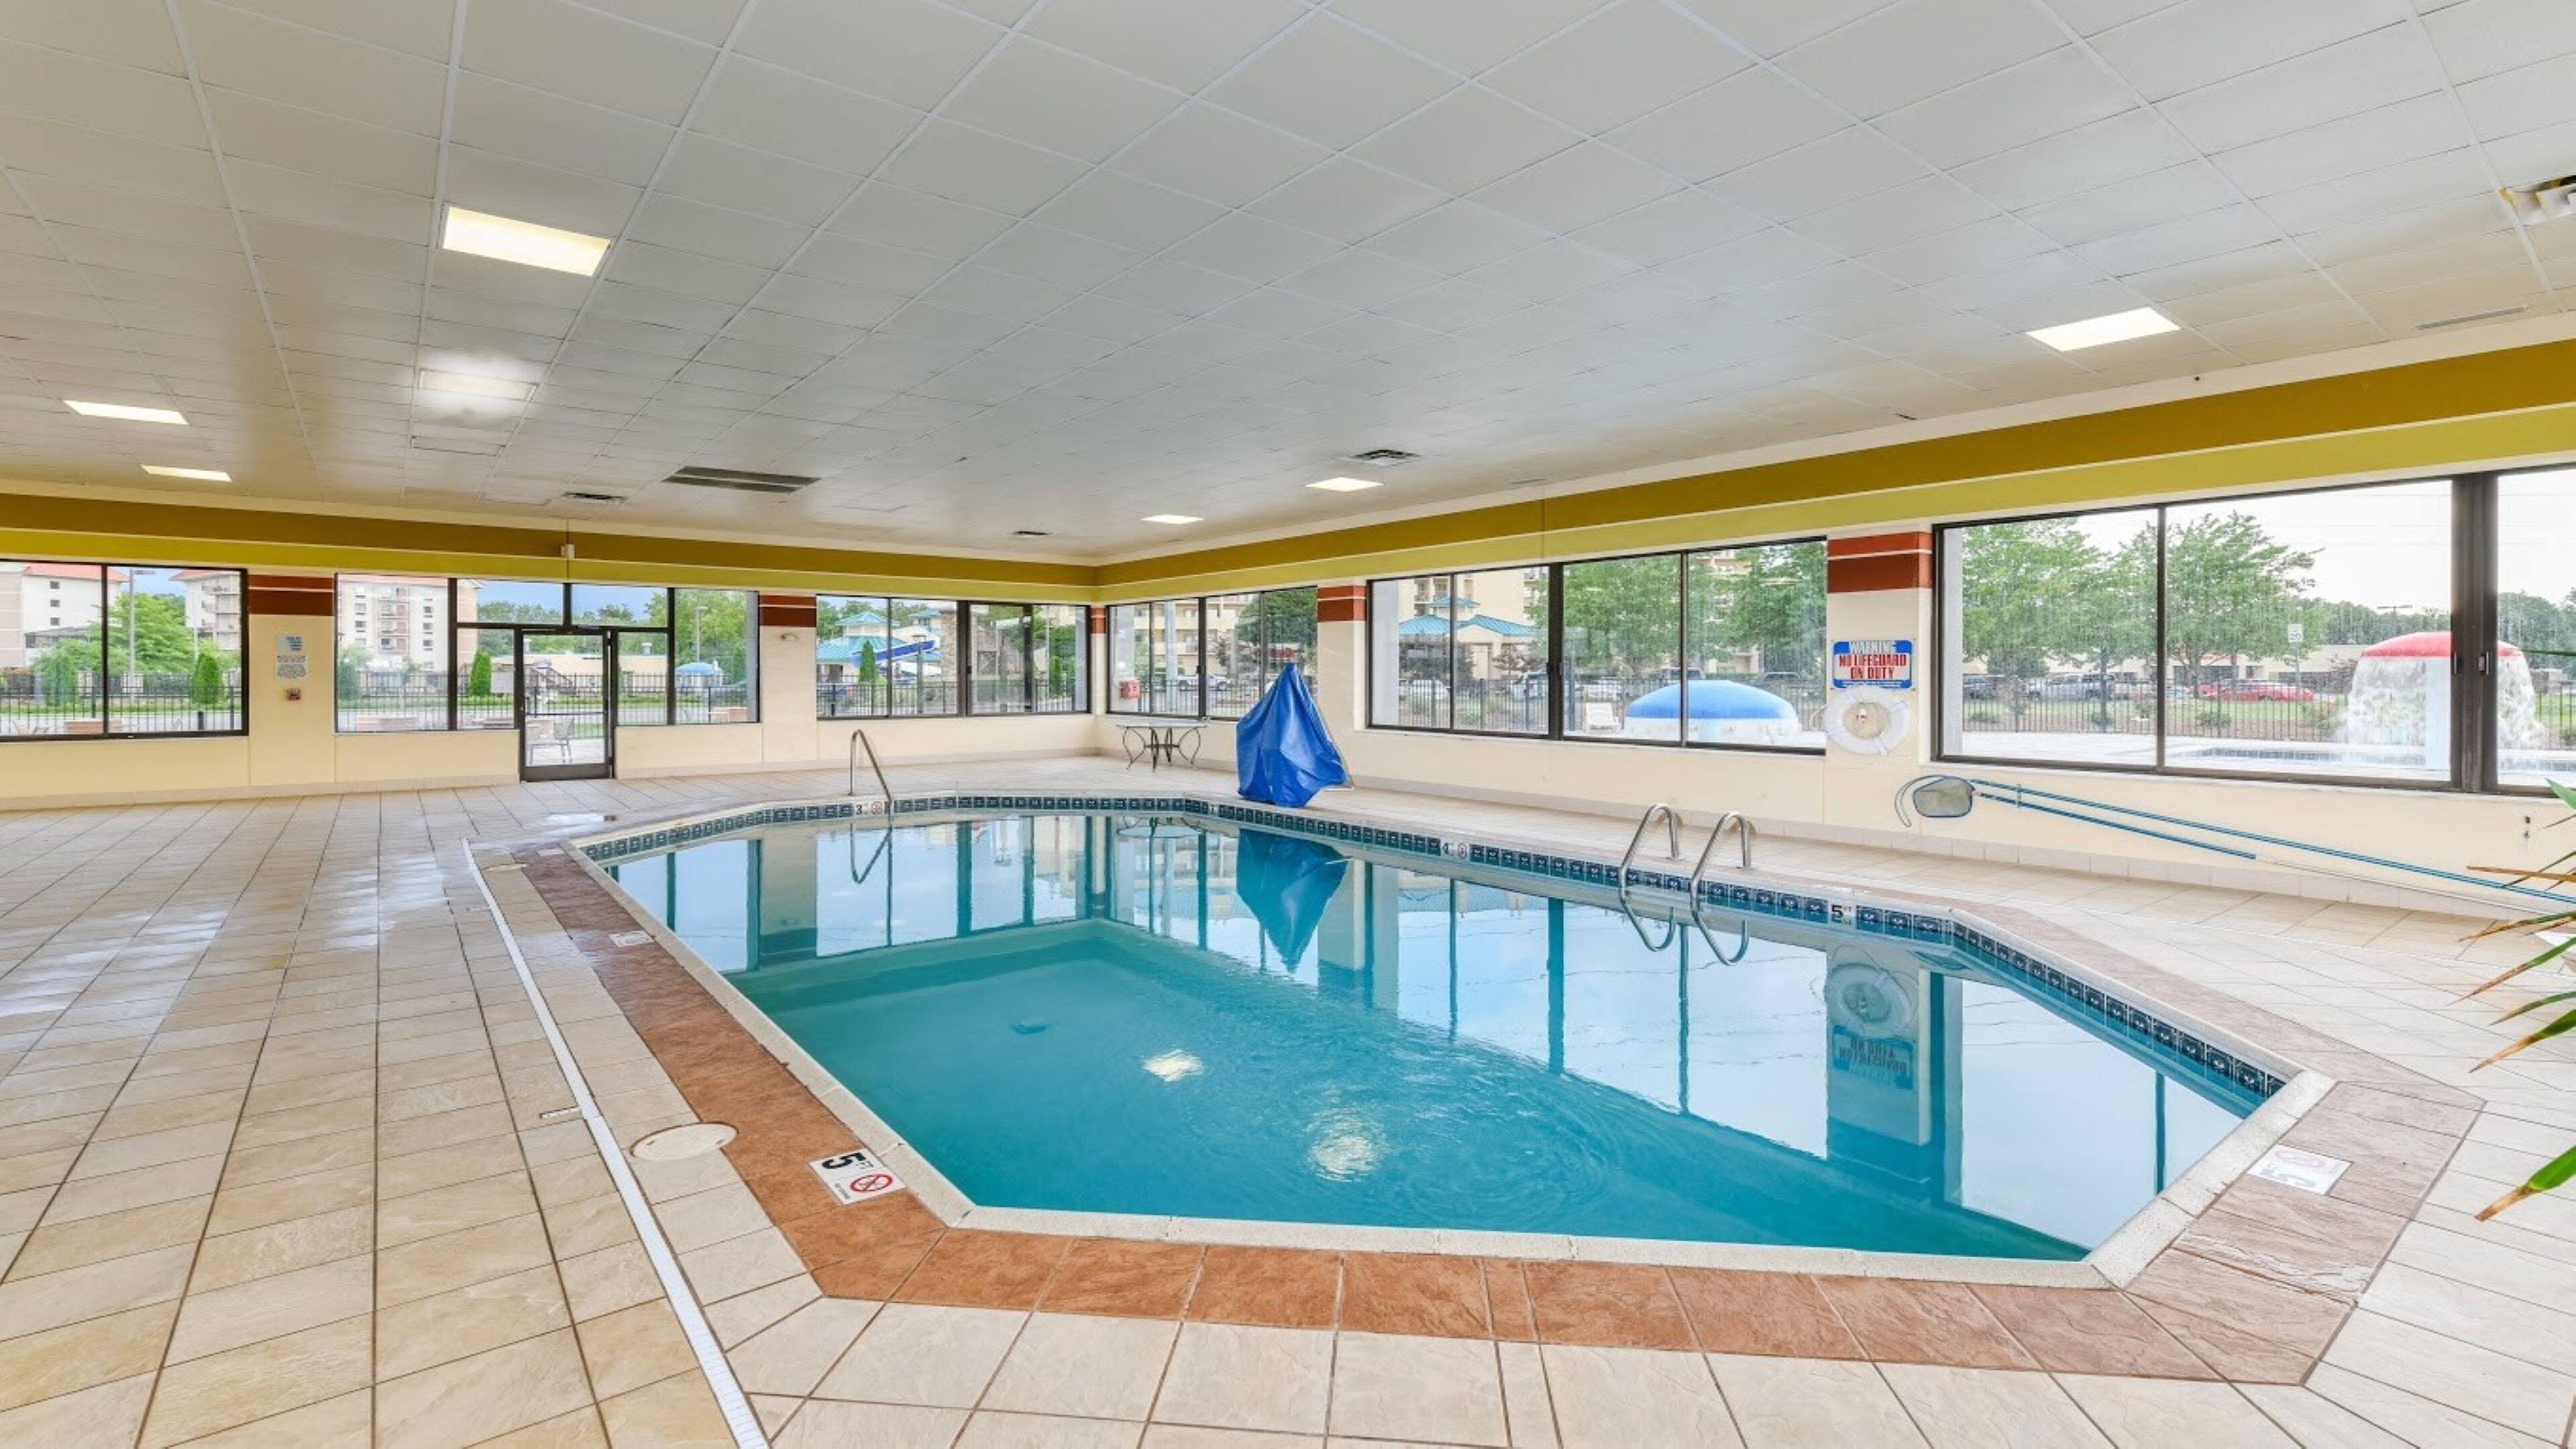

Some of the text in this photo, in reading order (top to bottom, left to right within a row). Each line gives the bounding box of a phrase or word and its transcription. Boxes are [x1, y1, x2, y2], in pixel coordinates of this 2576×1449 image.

[1839, 654, 1907, 666] NO LIFEGUARD
[1851, 667, 1894, 679] ON DUTY
[855, 804, 863, 814] 3
[1831, 905, 1843, 917] 5
[822, 1152, 866, 1169] 5
